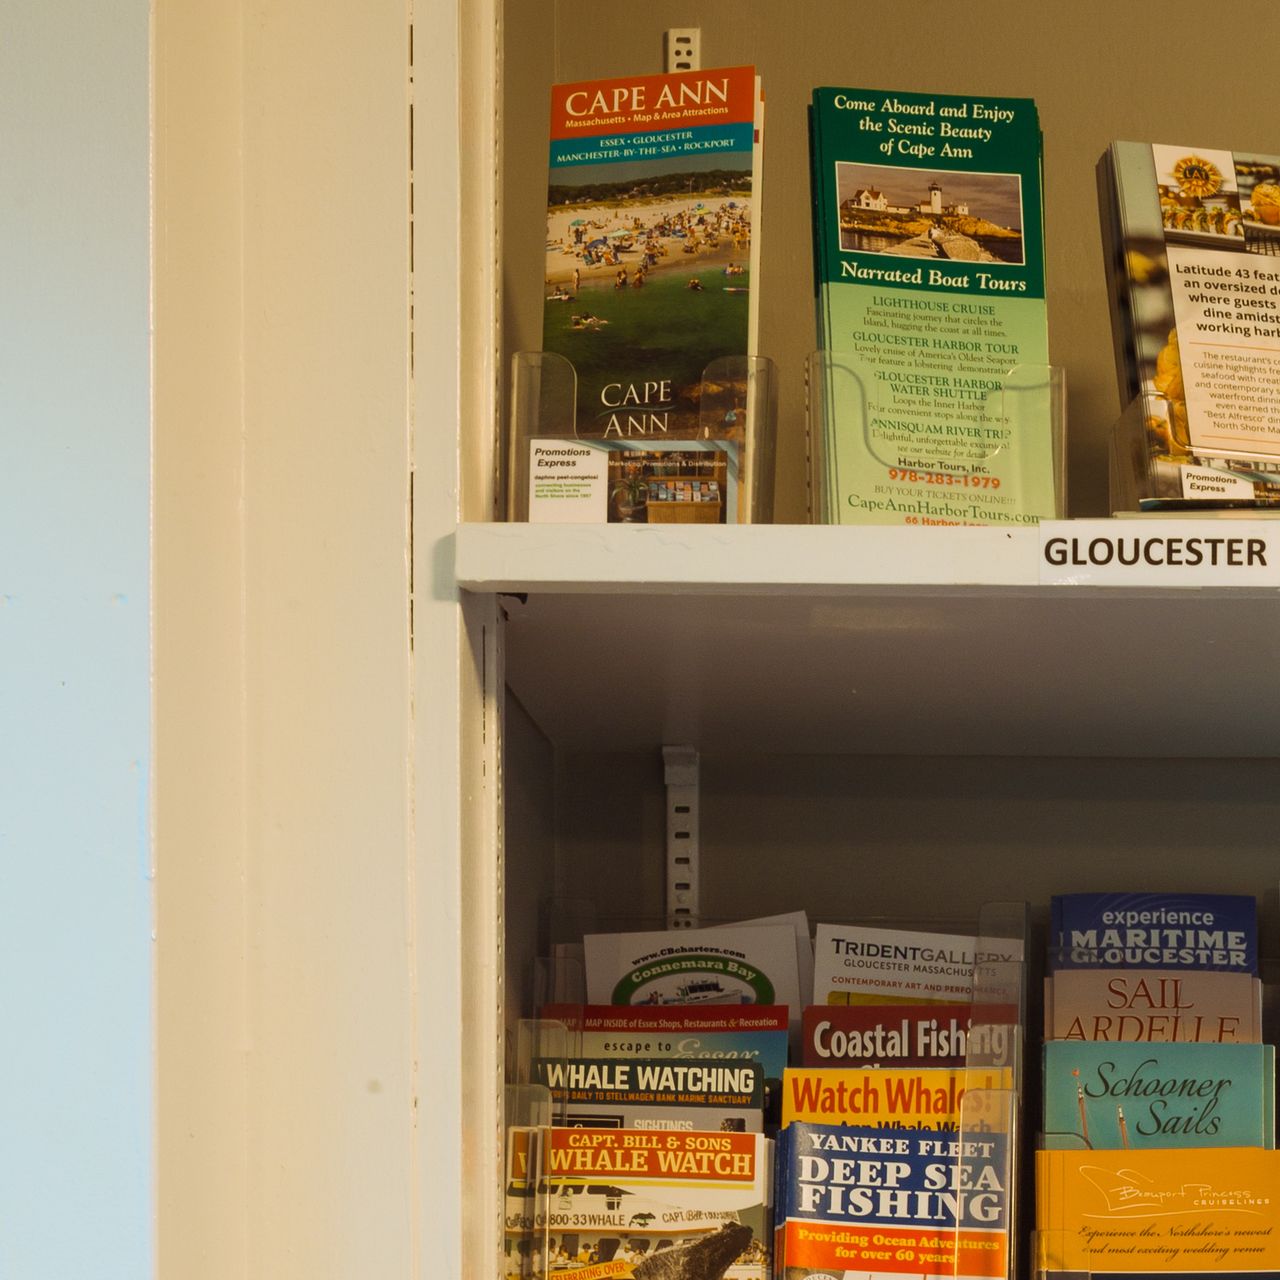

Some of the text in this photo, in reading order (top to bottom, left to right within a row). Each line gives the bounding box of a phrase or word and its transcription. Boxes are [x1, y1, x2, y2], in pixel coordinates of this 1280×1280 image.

[565, 78, 730, 118] CAPE ANN
[557, 138, 734, 163] MANCHESTER-BY-THE-SEA ROCKPORT
[600, 130, 693, 148] ESSEX GLOUCESTER
[840, 261, 1027, 292] Narrated Boat Tours
[1176, 263, 1231, 279] Latitude
[1235, 266, 1250, 279] 43
[1184, 278, 1200, 289] an
[1204, 278, 1267, 297] oversized
[1189, 292, 1229, 307] where
[1234, 296, 1276, 312] guests
[1203, 306, 1232, 319] dine
[1235, 309, 1280, 324] amidst
[1197, 320, 1250, 339] working
[600, 379, 672, 408] CAPE
[603, 413, 668, 438] ANN
[889, 468, 1001, 489] 978-283-1979
[1044, 537, 1268, 567] GLOUCESTER
[1103, 909, 1214, 928] experience
[1071, 930, 1247, 950] MARITIME
[1071, 948, 1248, 966] GLOUCESTER
[1107, 978, 1194, 1010] SAIL
[814, 1020, 1009, 1064] Coastal Fishing
[547, 1067, 754, 1093] WHALE WATCHING
[1085, 1060, 1232, 1098] Schooner
[792, 1076, 992, 1115] Watch Whales!
[1136, 1099, 1220, 1136] Sails
[569, 1135, 731, 1151] CAPT. BILL & SONS
[809, 1134, 994, 1158] YANKEE FLEET
[550, 1149, 751, 1175] WHALE WATCH
[799, 1156, 1004, 1191] DEEP SEA
[800, 1187, 1001, 1221] FISHING
